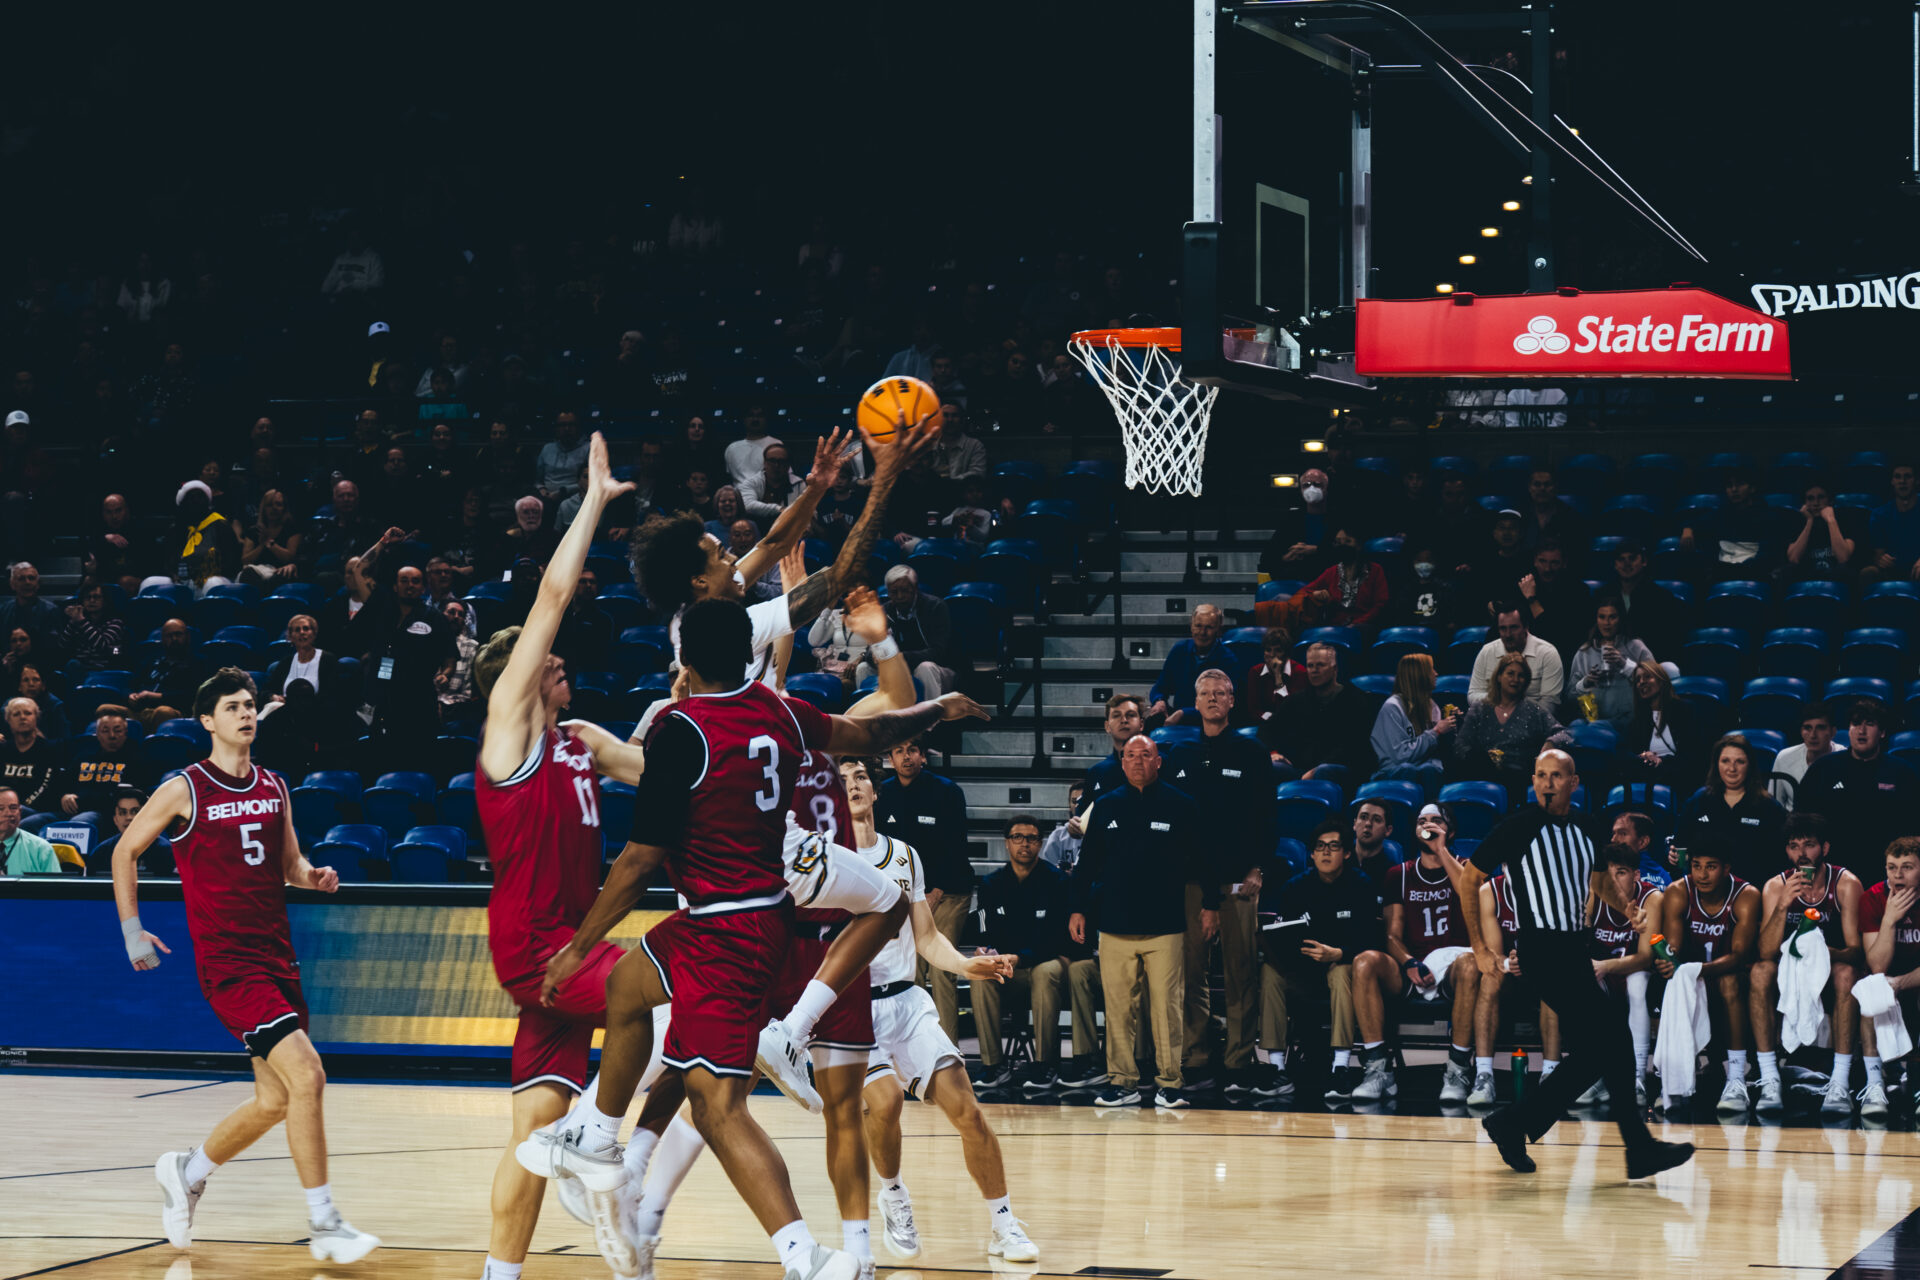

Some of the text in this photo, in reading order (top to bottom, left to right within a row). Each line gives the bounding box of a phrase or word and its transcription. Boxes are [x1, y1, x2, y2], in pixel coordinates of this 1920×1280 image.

[4, 763, 34, 778] UCI
[78, 761, 126, 782] UCI
[748, 734, 781, 812] 3
[206, 798, 281, 821] BELMONT
[572, 775, 600, 828] 11
[239, 822, 266, 866] 5
[1409, 889, 1451, 902] BELMO
